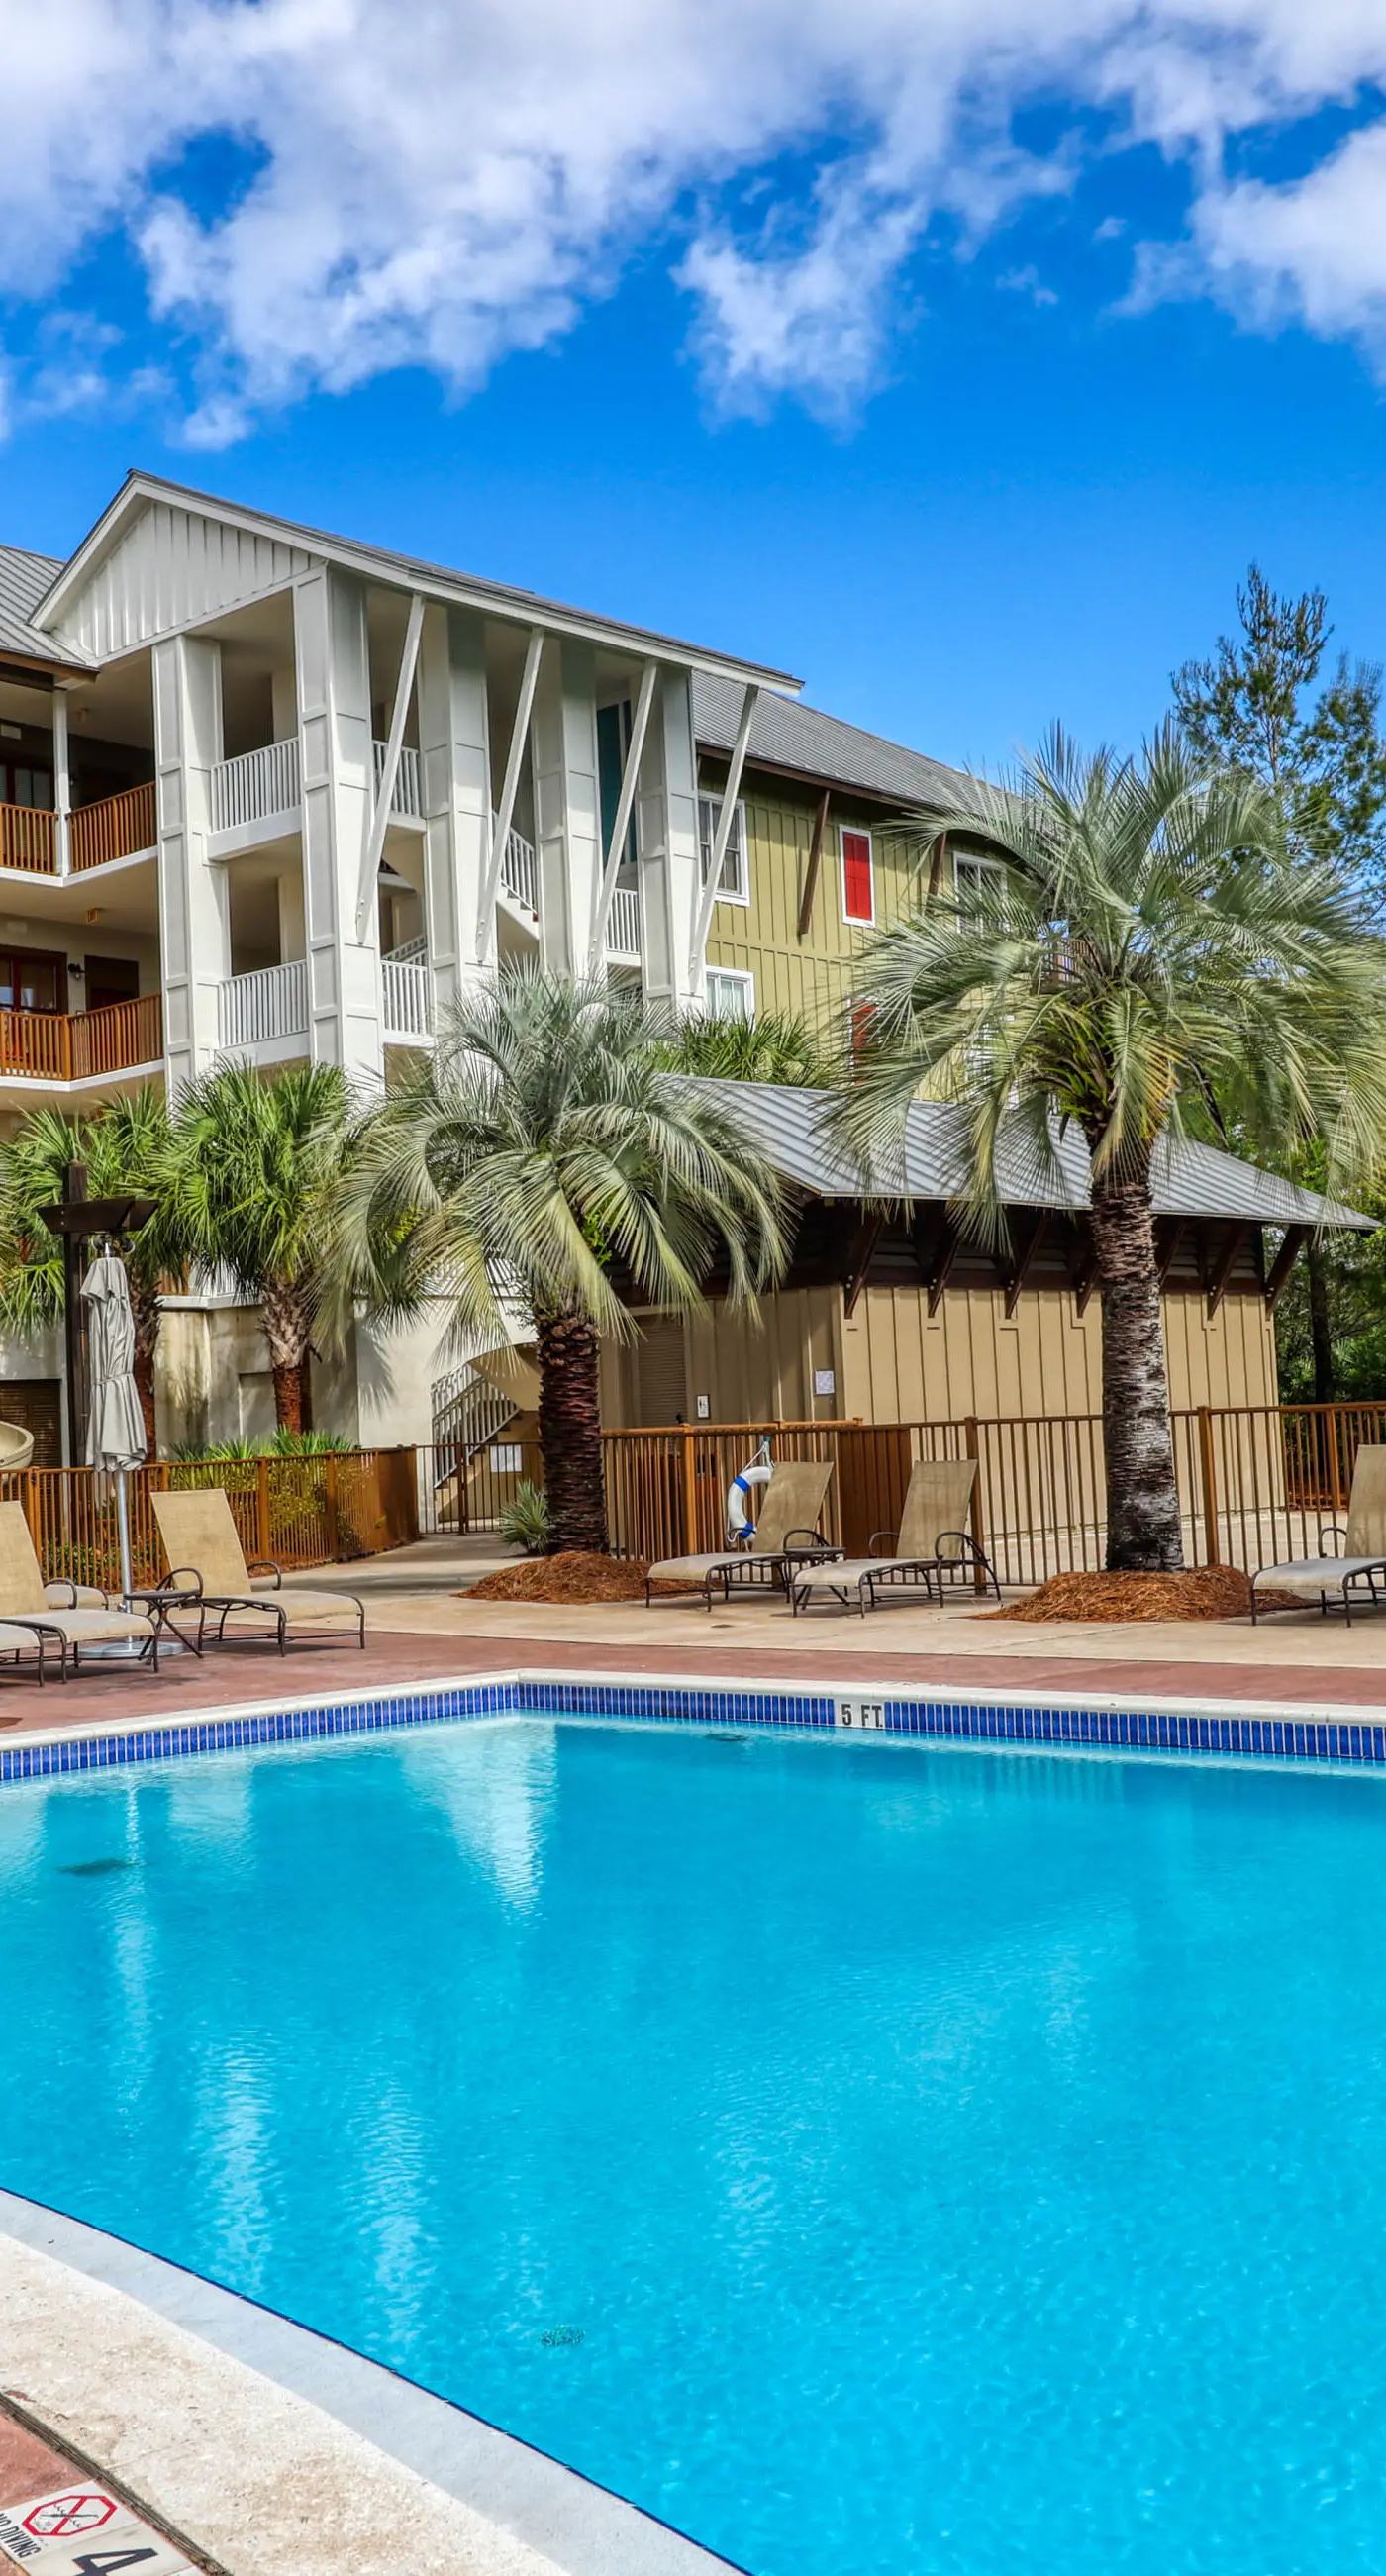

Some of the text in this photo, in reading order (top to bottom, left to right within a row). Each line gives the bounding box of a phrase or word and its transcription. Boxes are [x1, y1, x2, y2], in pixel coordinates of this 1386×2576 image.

[842, 1703, 883, 1728] 5 FT.
[0, 2526, 42, 2558] DIVING
[72, 2547, 158, 2576] 4
